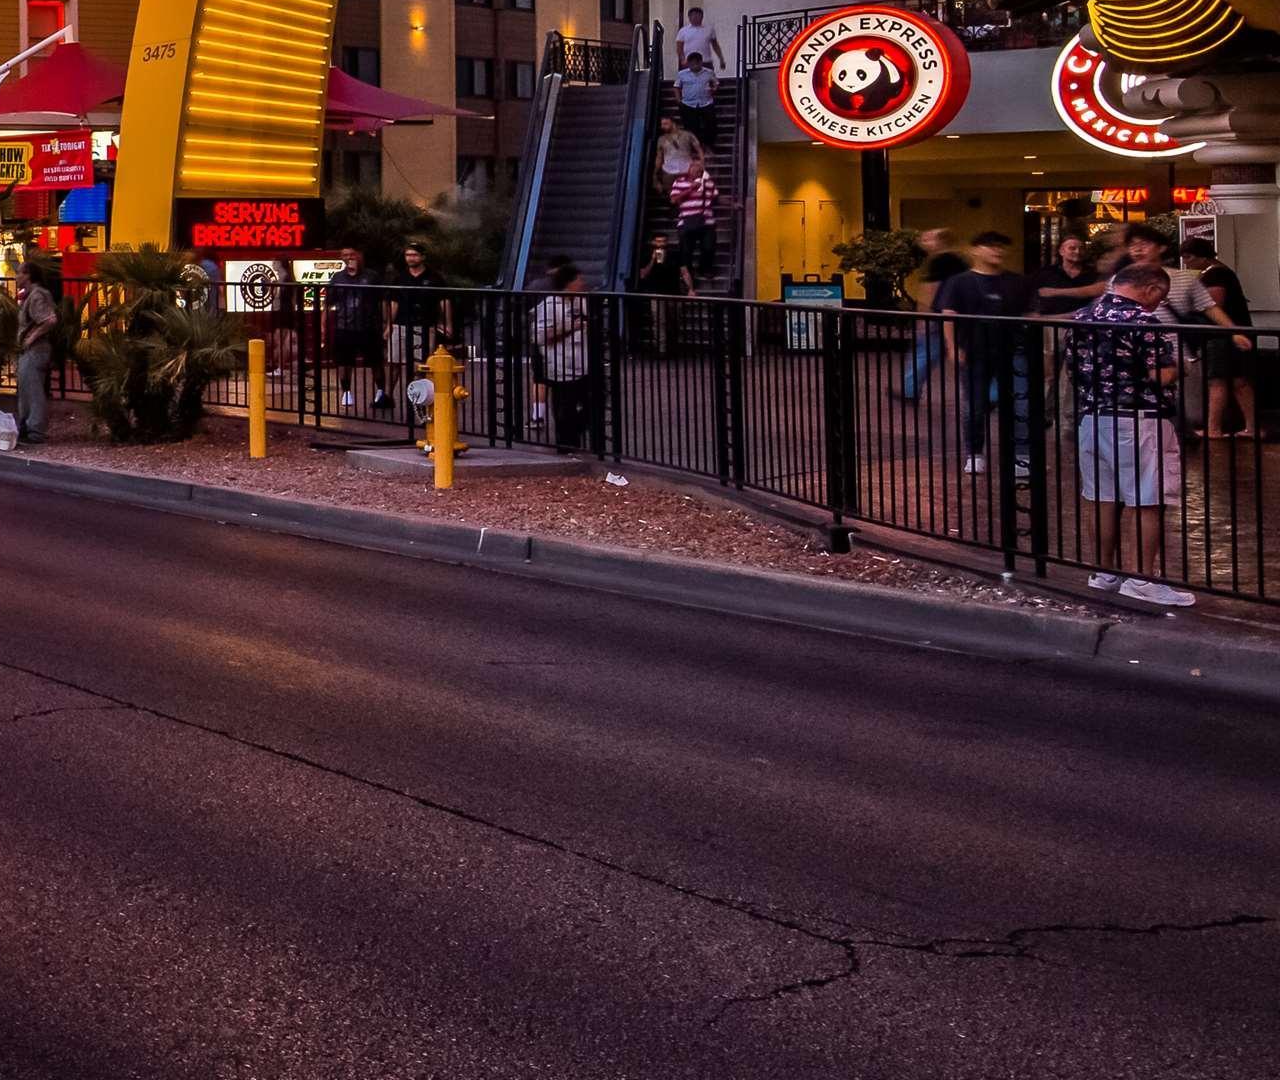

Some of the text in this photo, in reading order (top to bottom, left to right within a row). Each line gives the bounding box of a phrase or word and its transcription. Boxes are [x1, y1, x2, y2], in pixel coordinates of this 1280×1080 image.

[143, 42, 176, 62] 3475
[794, 17, 938, 74] PANDA EXPRESS
[799, 93, 932, 137] CHINESE KITCHEN
[214, 202, 299, 224] SERVING
[192, 224, 305, 247] BREAKFAST
[241, 265, 277, 283] CHIPOTLE
[302, 271, 324, 280] NEW
